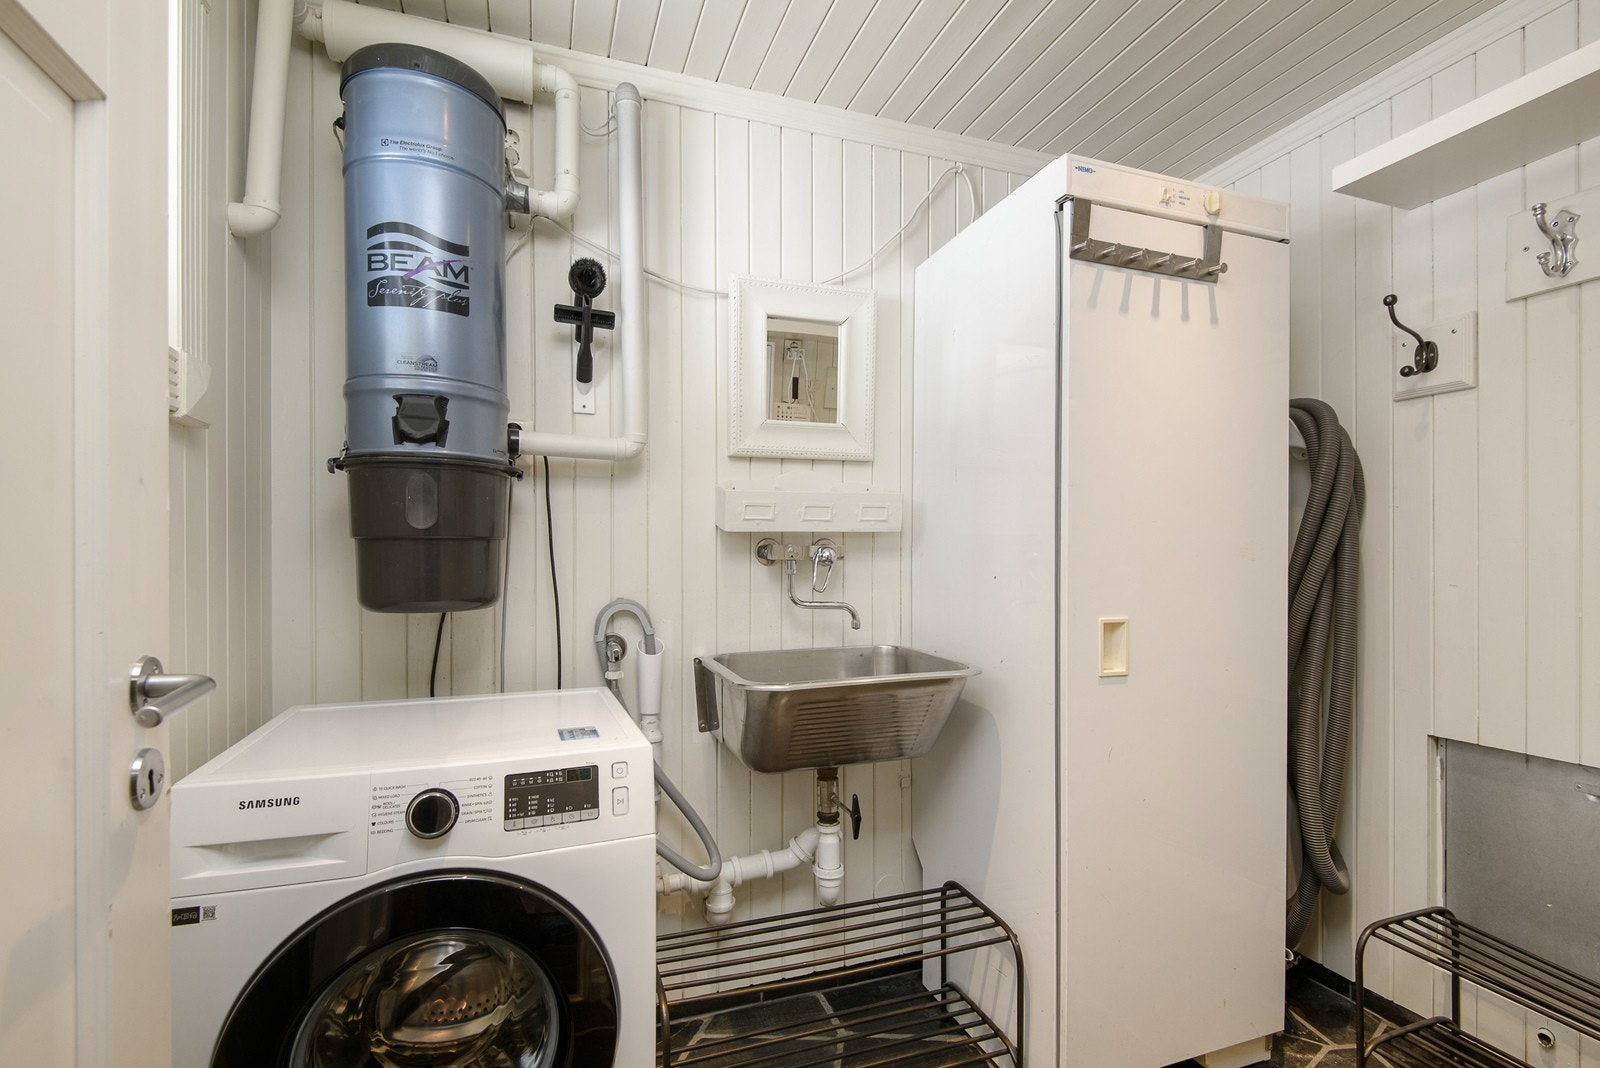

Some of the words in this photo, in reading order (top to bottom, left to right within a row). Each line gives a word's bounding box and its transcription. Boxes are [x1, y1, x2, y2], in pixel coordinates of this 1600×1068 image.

[400, 140, 425, 148] Electrolux
[366, 253, 469, 284] BEAM
[238, 796, 300, 810] SAMSUNG
